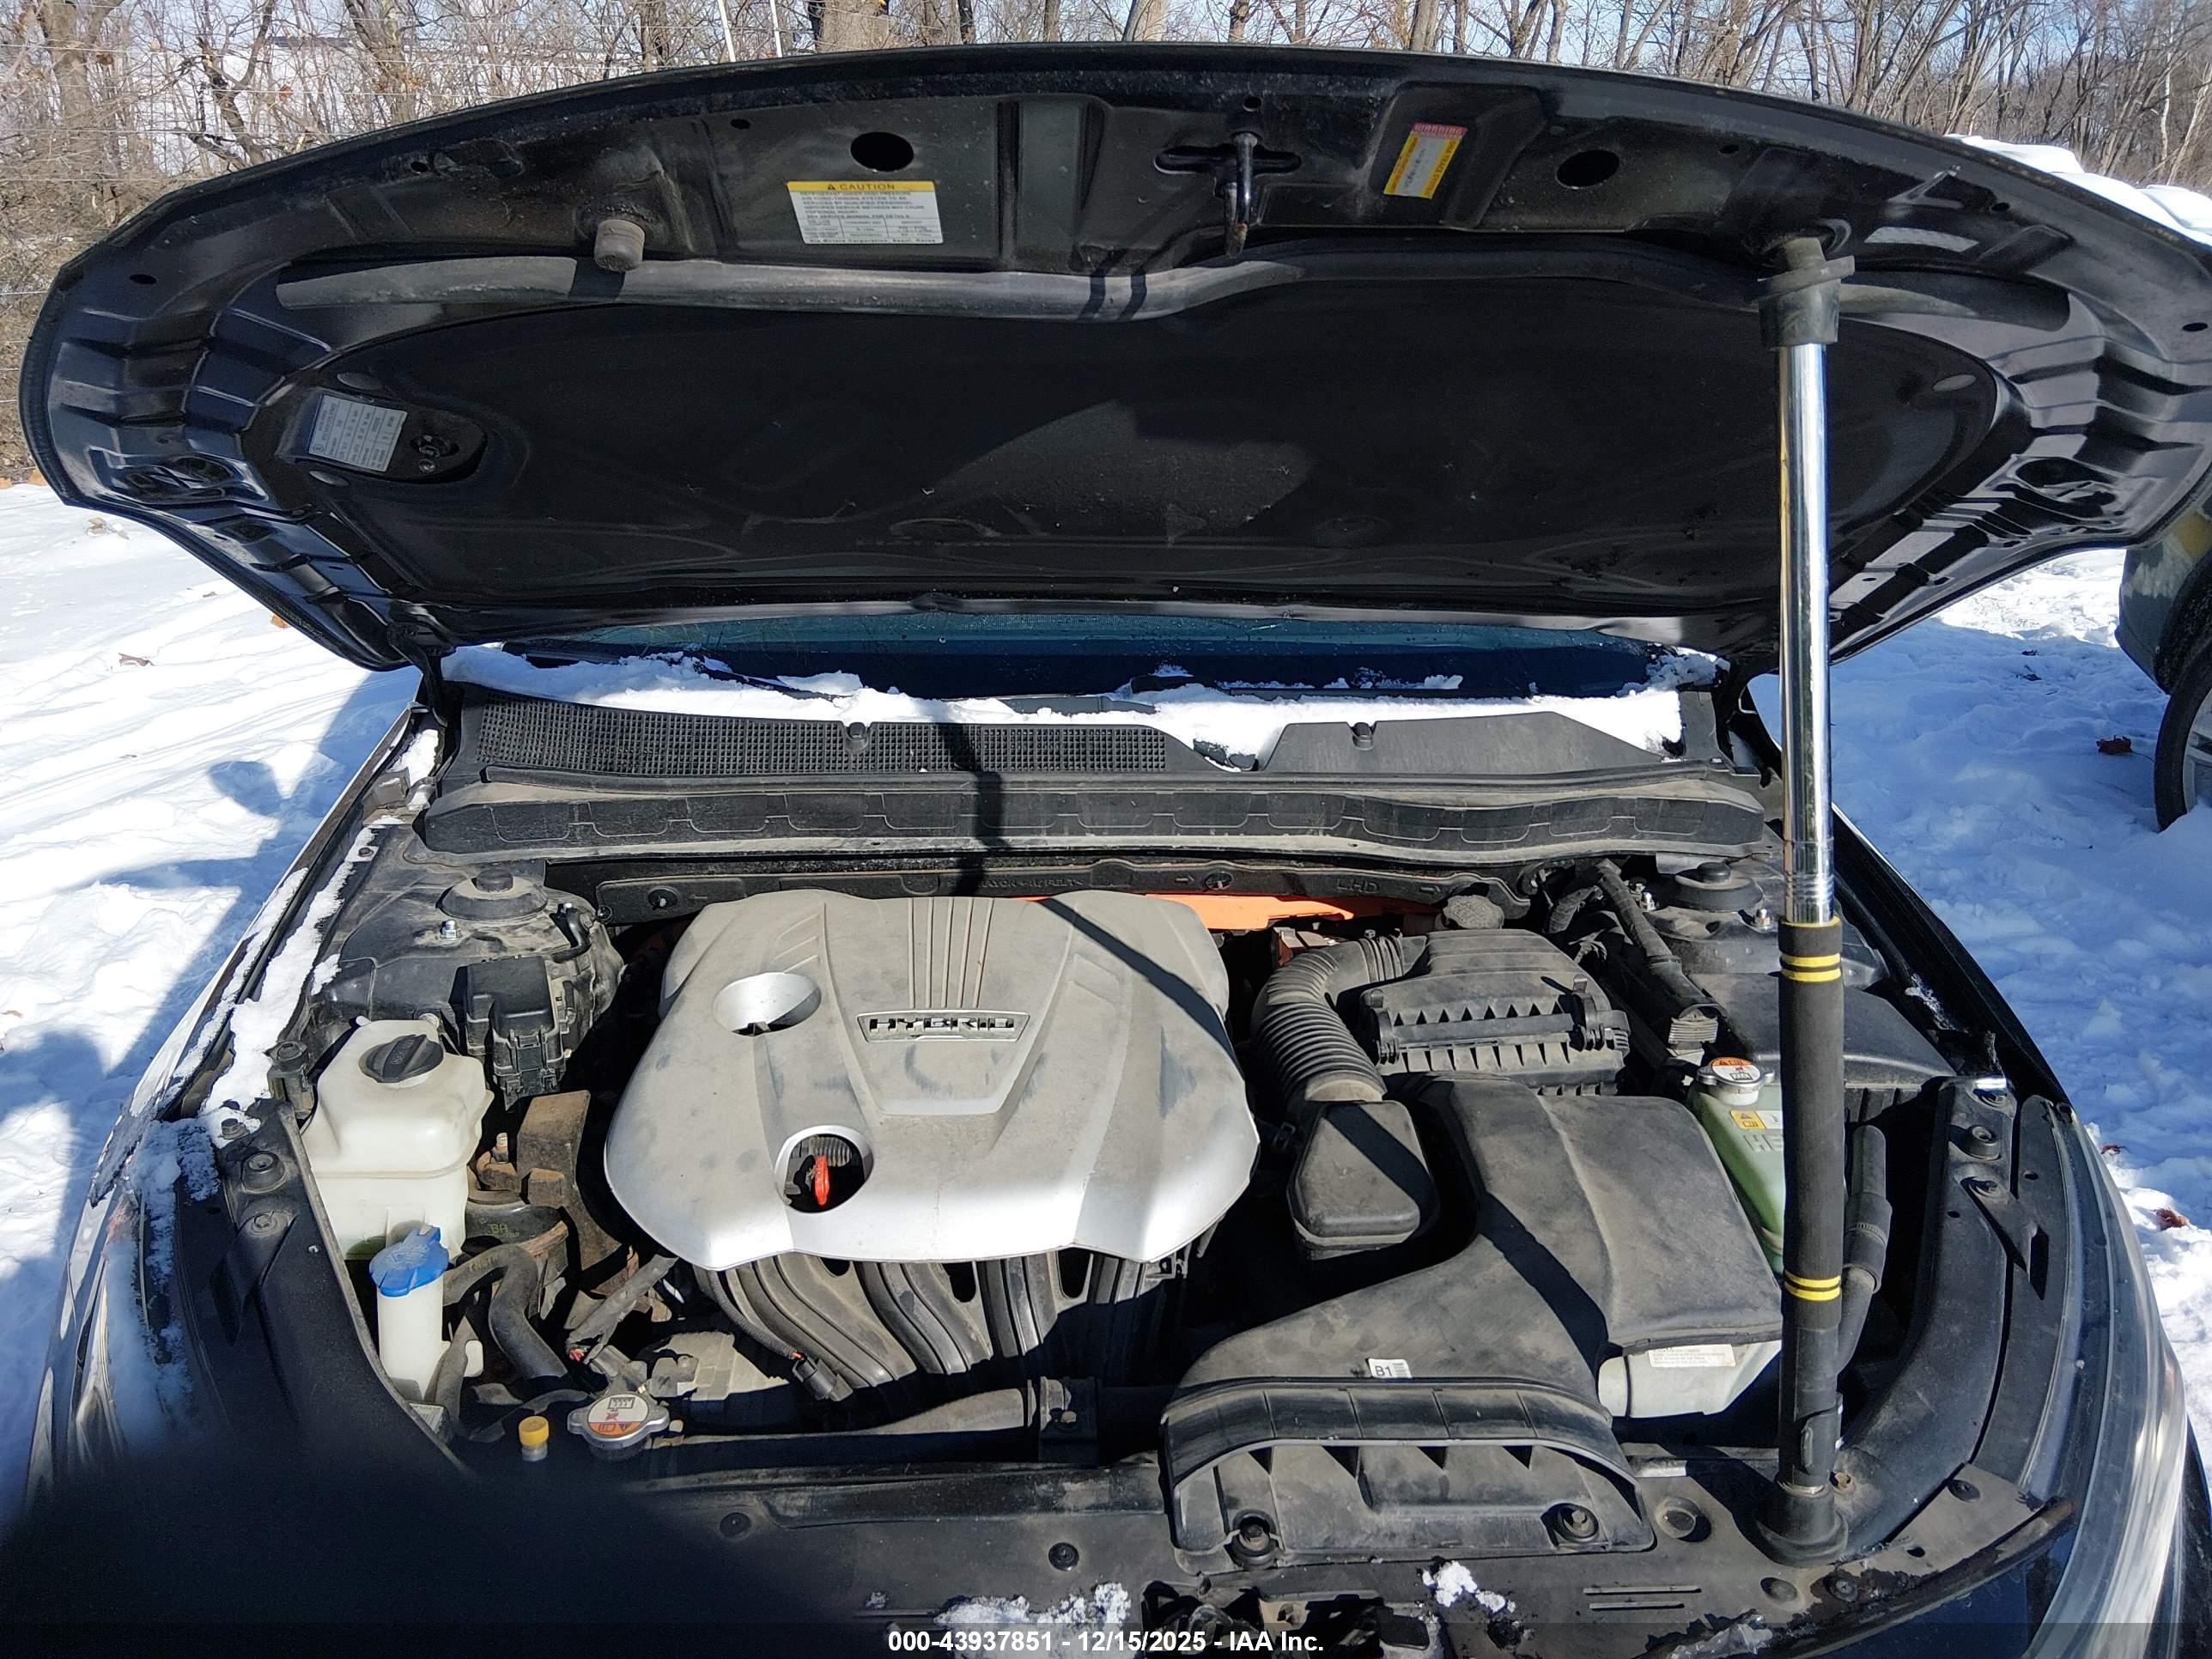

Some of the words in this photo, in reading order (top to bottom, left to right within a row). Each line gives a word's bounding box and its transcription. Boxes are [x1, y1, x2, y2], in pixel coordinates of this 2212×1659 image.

[1413, 123, 1463, 135] WARNING
[869, 1016, 1016, 1032] HYBRID
[1374, 1365, 1393, 1376] B1
